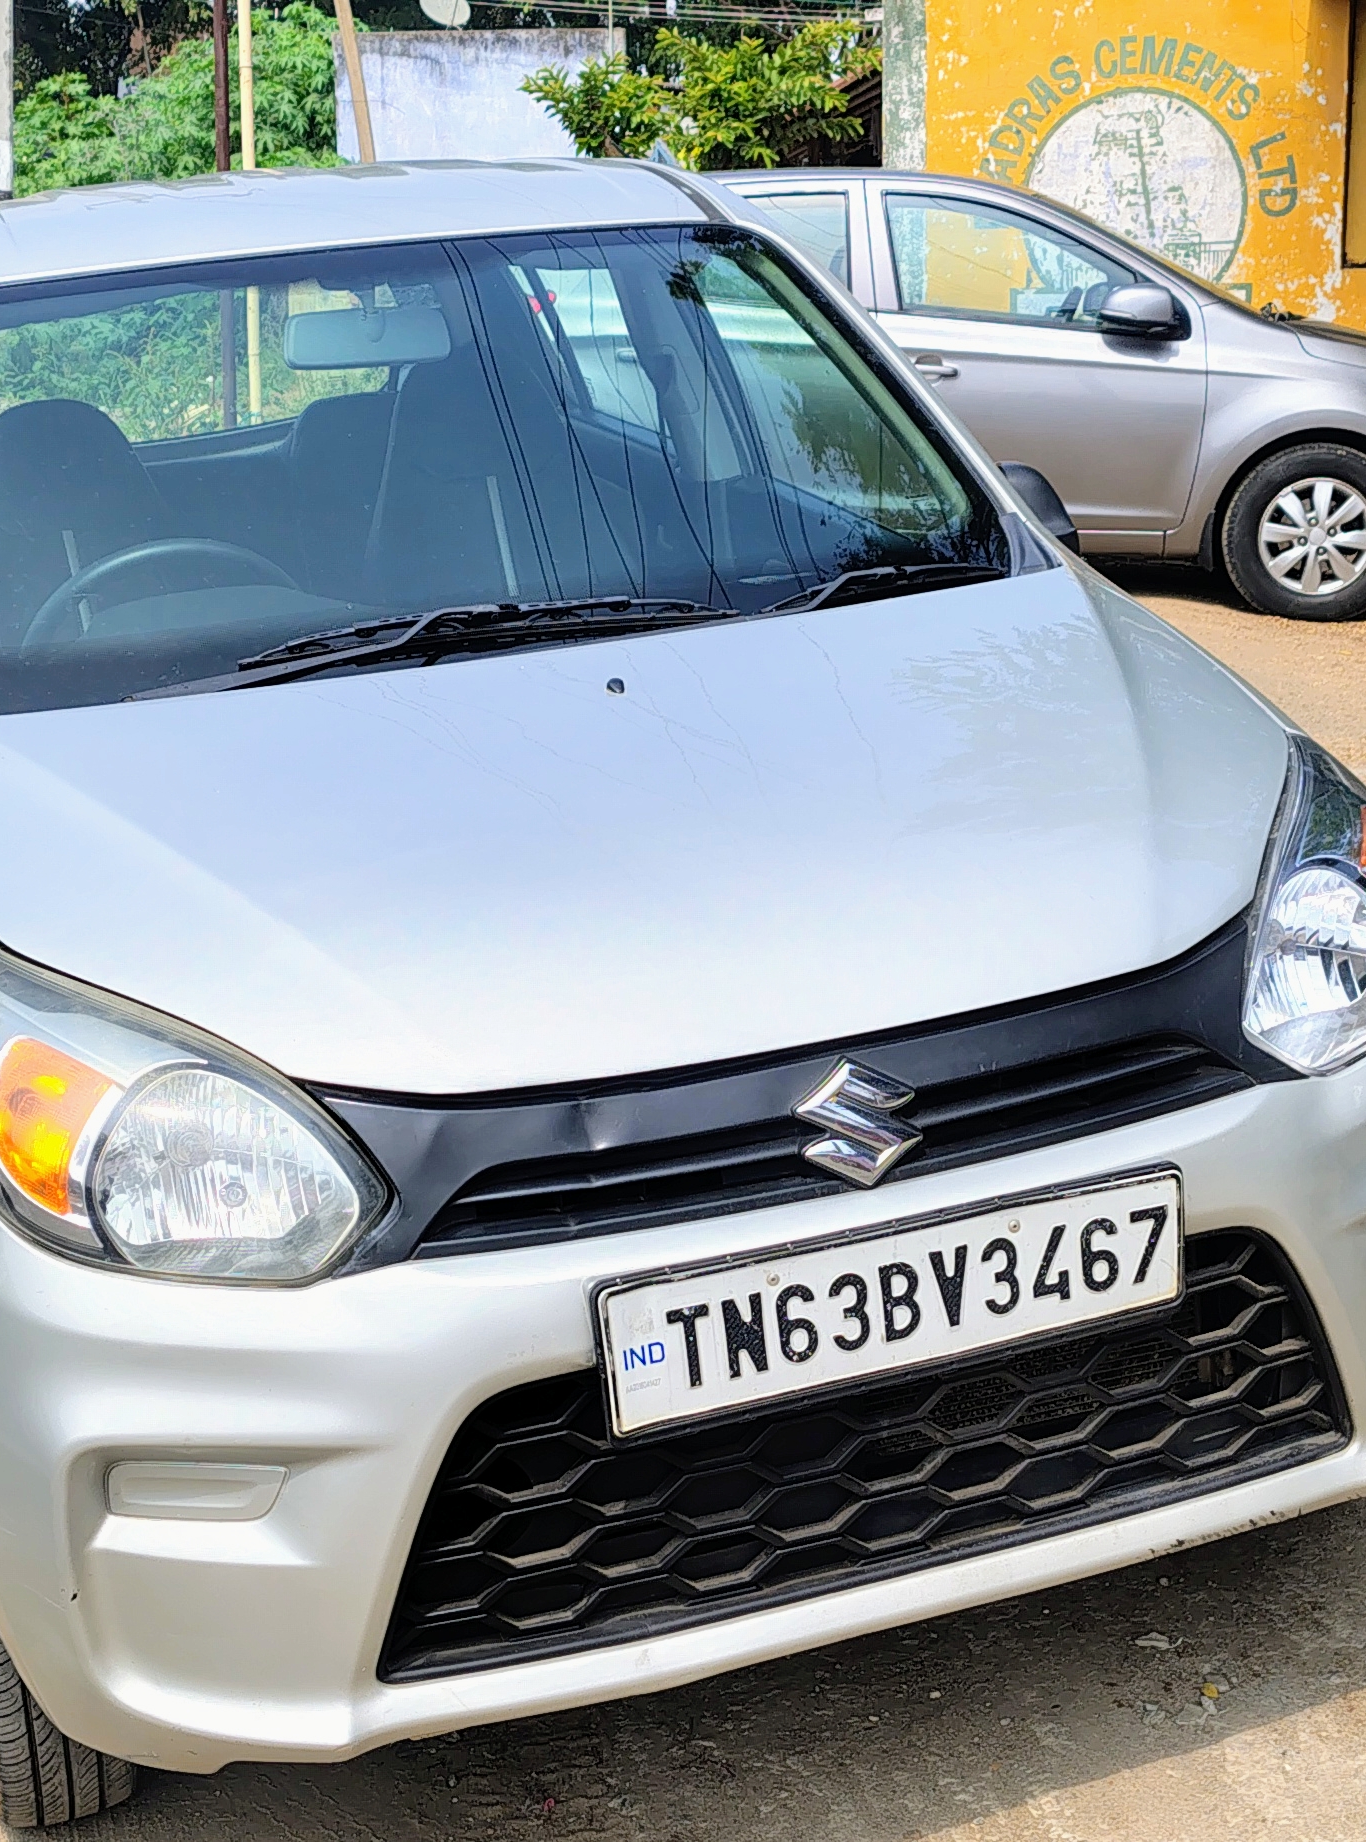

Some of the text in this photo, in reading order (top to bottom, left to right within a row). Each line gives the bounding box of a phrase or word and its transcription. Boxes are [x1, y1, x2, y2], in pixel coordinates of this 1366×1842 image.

[980, 35, 1299, 218] ADRAS CEMENTS LTD
[623, 1203, 1169, 1389] IND TN63BV3467
